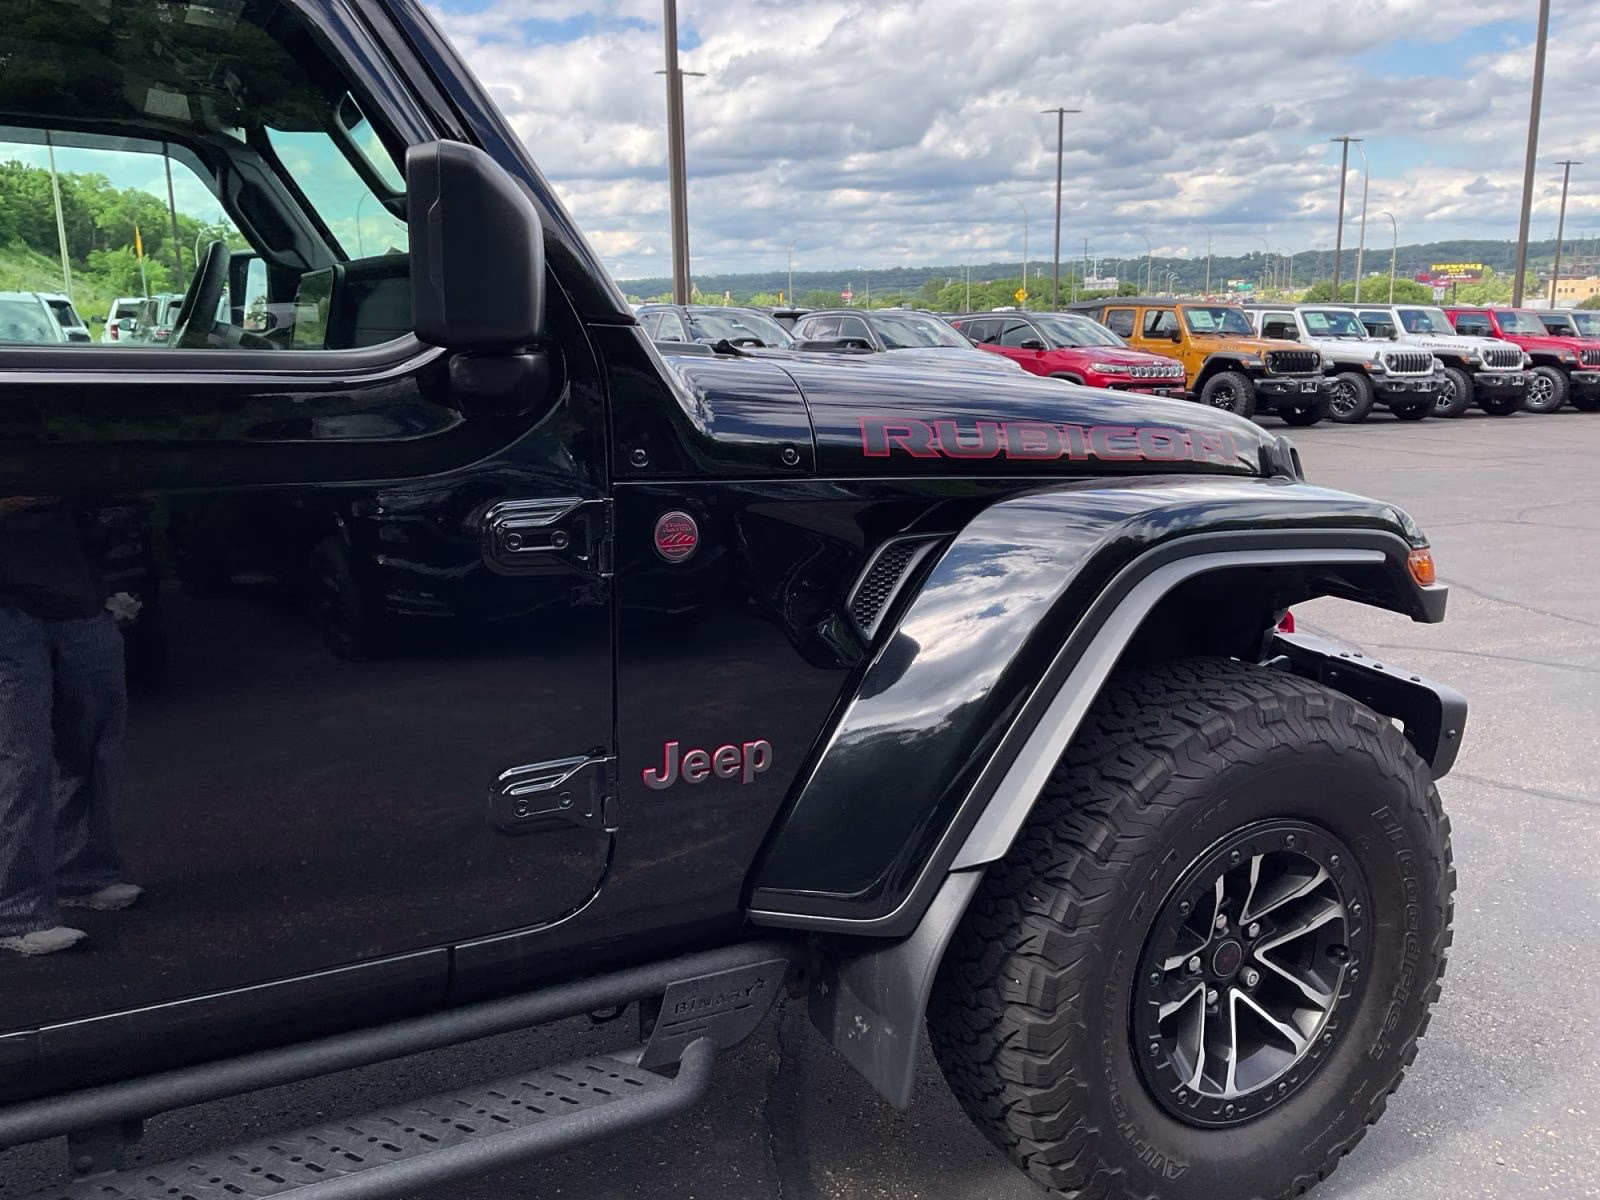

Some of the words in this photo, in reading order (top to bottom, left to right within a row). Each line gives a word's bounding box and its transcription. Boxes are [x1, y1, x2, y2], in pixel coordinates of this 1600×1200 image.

[1421, 341, 1469, 349] RUBICON
[858, 416, 1239, 462] RUBICON
[642, 739, 773, 790] Jeep
